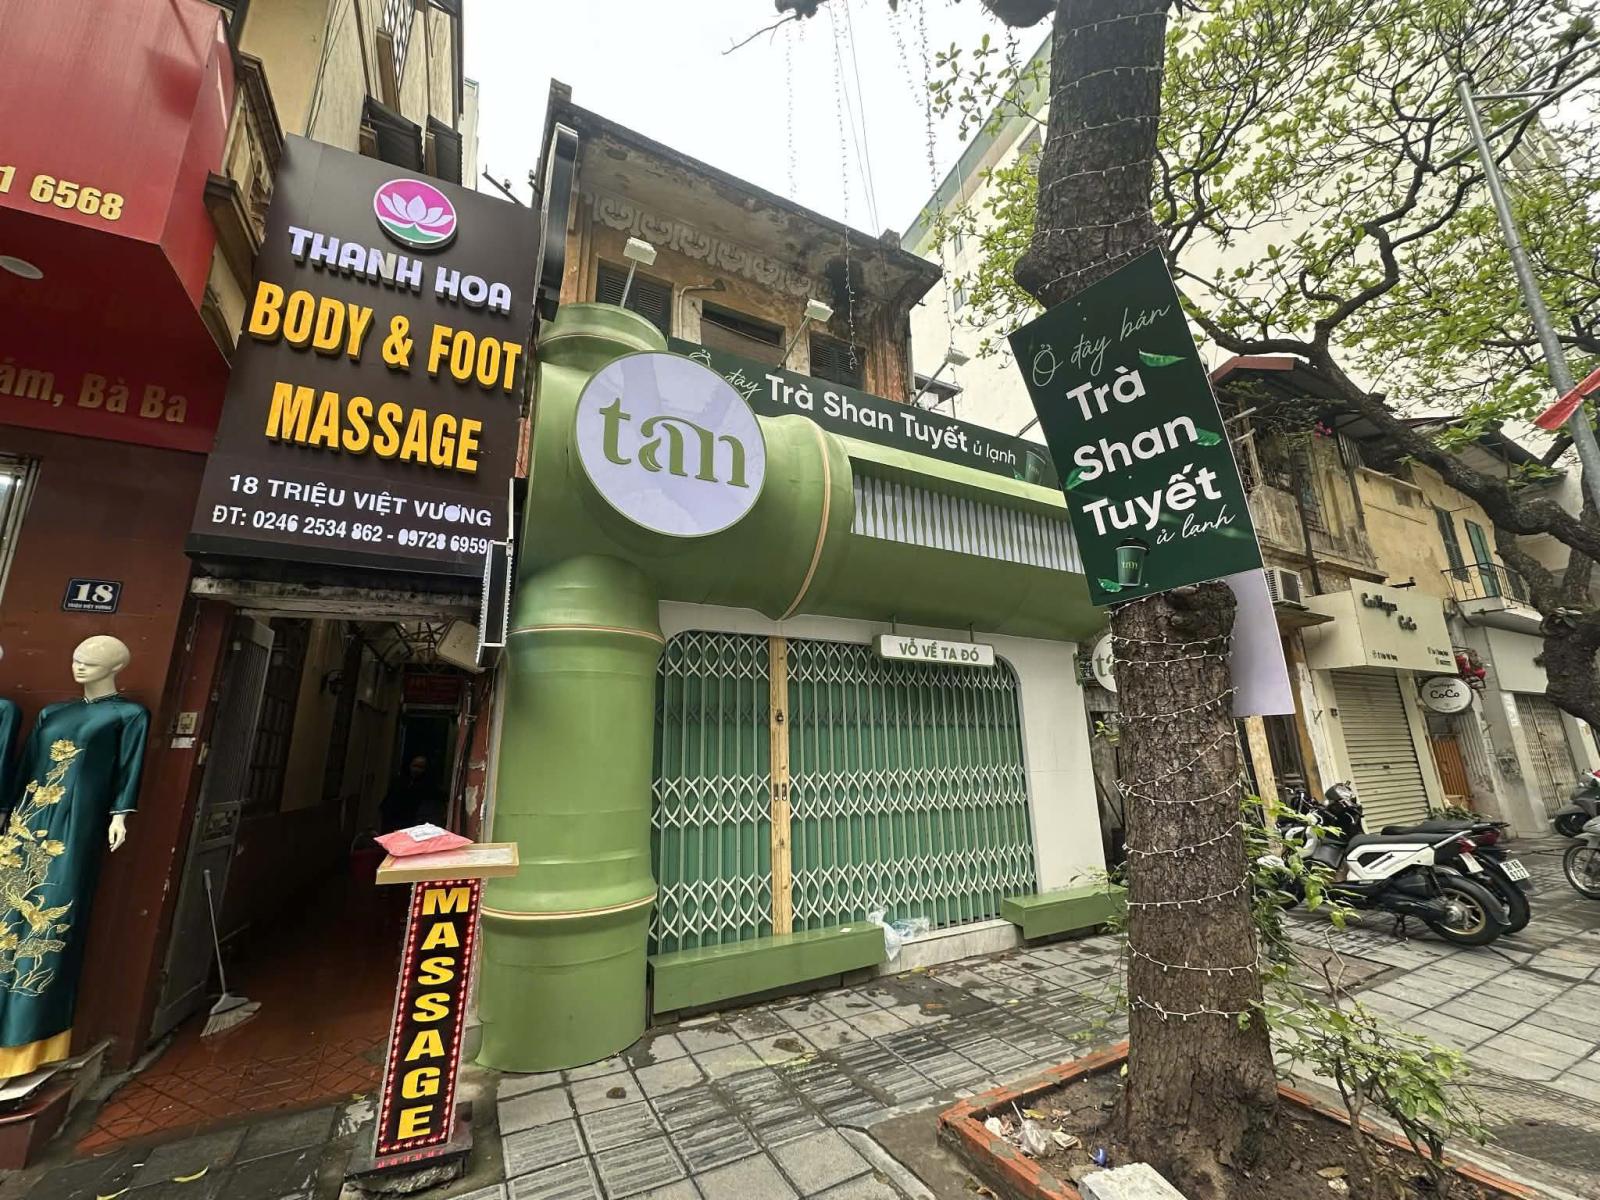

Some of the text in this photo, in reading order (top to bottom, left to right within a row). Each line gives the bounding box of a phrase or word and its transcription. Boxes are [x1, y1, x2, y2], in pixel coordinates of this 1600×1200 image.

[30, 173, 125, 221] 6568
[288, 225, 513, 312] THANH HOA
[248, 280, 523, 393] BODY & FOOT
[1070, 333, 1112, 377] đây
[1119, 304, 1171, 342] bán
[77, 372, 130, 414] Bà
[139, 384, 188, 424] Ba
[765, 373, 814, 411] Trà
[823, 390, 894, 433] Shan
[899, 411, 968, 453] Tuyết
[972, 439, 982, 456] ủ
[985, 443, 1017, 466] lạnh
[1066, 364, 1147, 421] Trà
[265, 381, 483, 473] MASSAGE
[598, 396, 751, 488] tan
[1073, 414, 1199, 482] Shan
[212, 504, 247, 526] ĐT:
[252, 510, 299, 532] 0246
[303, 517, 347, 538] 2534
[351, 522, 383, 542] 862
[398, 528, 446, 550] 09728
[450, 535, 490, 555] 6959
[229, 474, 492, 527] 18 TRIỆU VIỆT VƯƠNG
[1083, 462, 1223, 536] Tuyết
[1156, 503, 1236, 545] ủ lạnh
[72, 582, 113, 603] 18
[941, 647, 957, 660] TA
[961, 647, 979, 662] ĐÓ
[1430, 688, 1460, 699] CoCo
[396, 887, 471, 1140] MASSAGE
